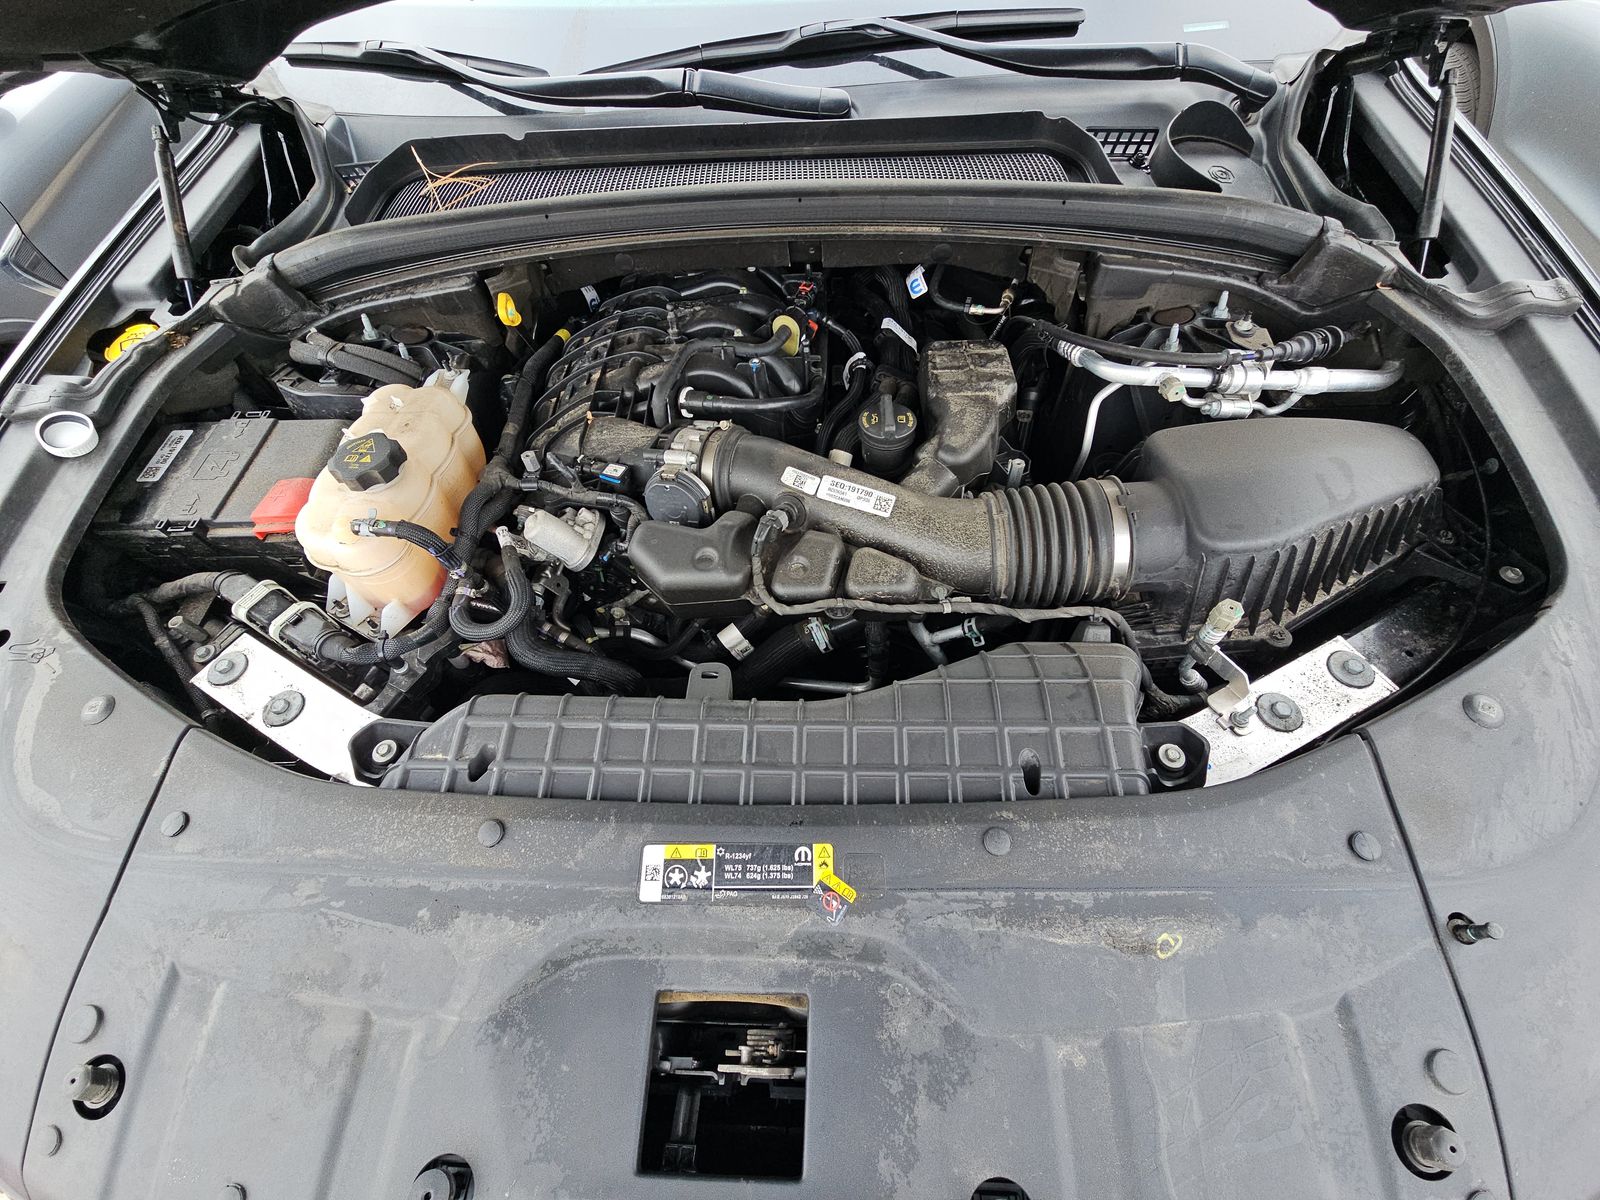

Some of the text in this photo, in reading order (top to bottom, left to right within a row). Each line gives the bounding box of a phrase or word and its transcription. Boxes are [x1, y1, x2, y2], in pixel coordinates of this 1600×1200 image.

[725, 852, 752, 860] R-1234yf
[746, 864, 761, 872] 737g
[762, 864, 781, 872] (1.625
[781, 864, 794, 872] lbs)
[781, 872, 794, 880] lbs)
